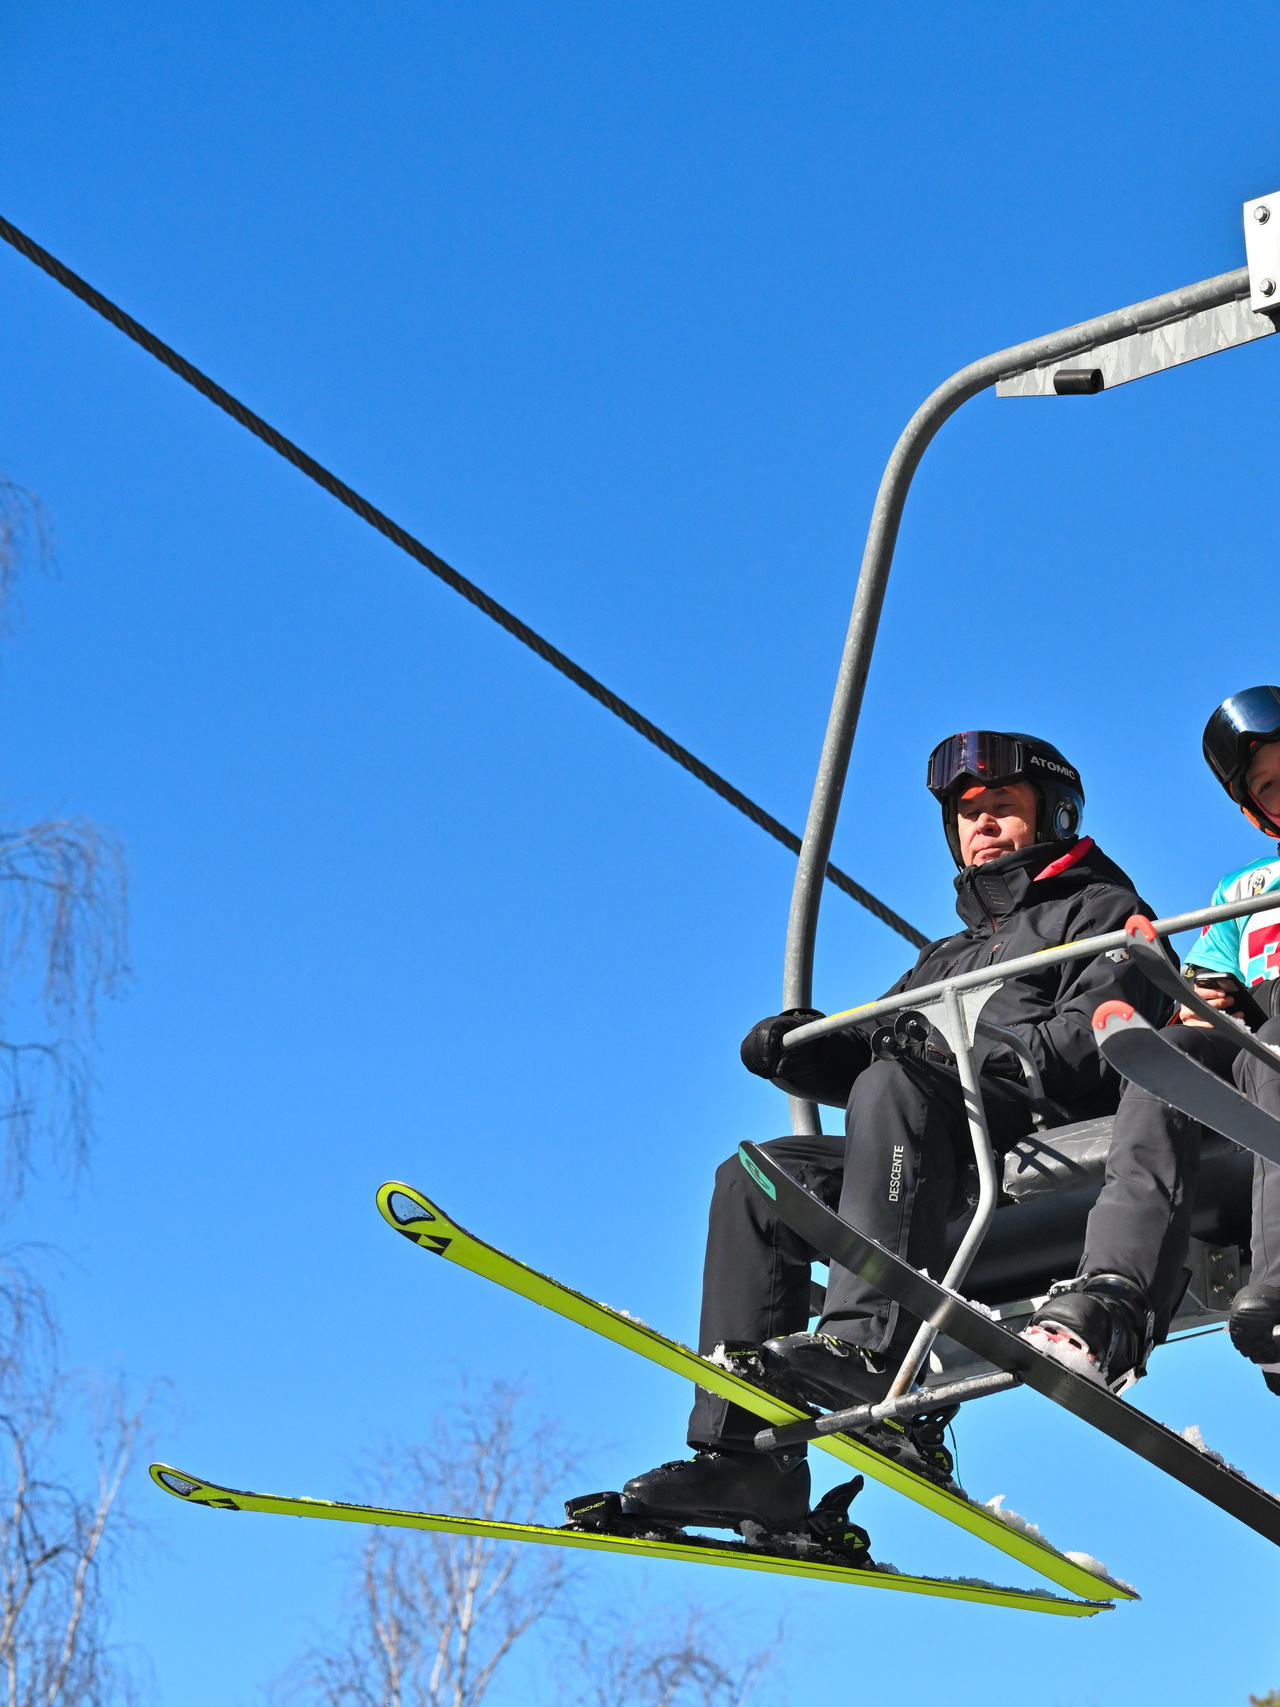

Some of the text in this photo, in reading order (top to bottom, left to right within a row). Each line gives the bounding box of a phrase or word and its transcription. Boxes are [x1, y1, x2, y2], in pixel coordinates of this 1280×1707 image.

[1030, 755, 1076, 780] ATOMIC
[889, 1145, 904, 1202] DESCENTE
[573, 1500, 606, 1516] FISCHER
